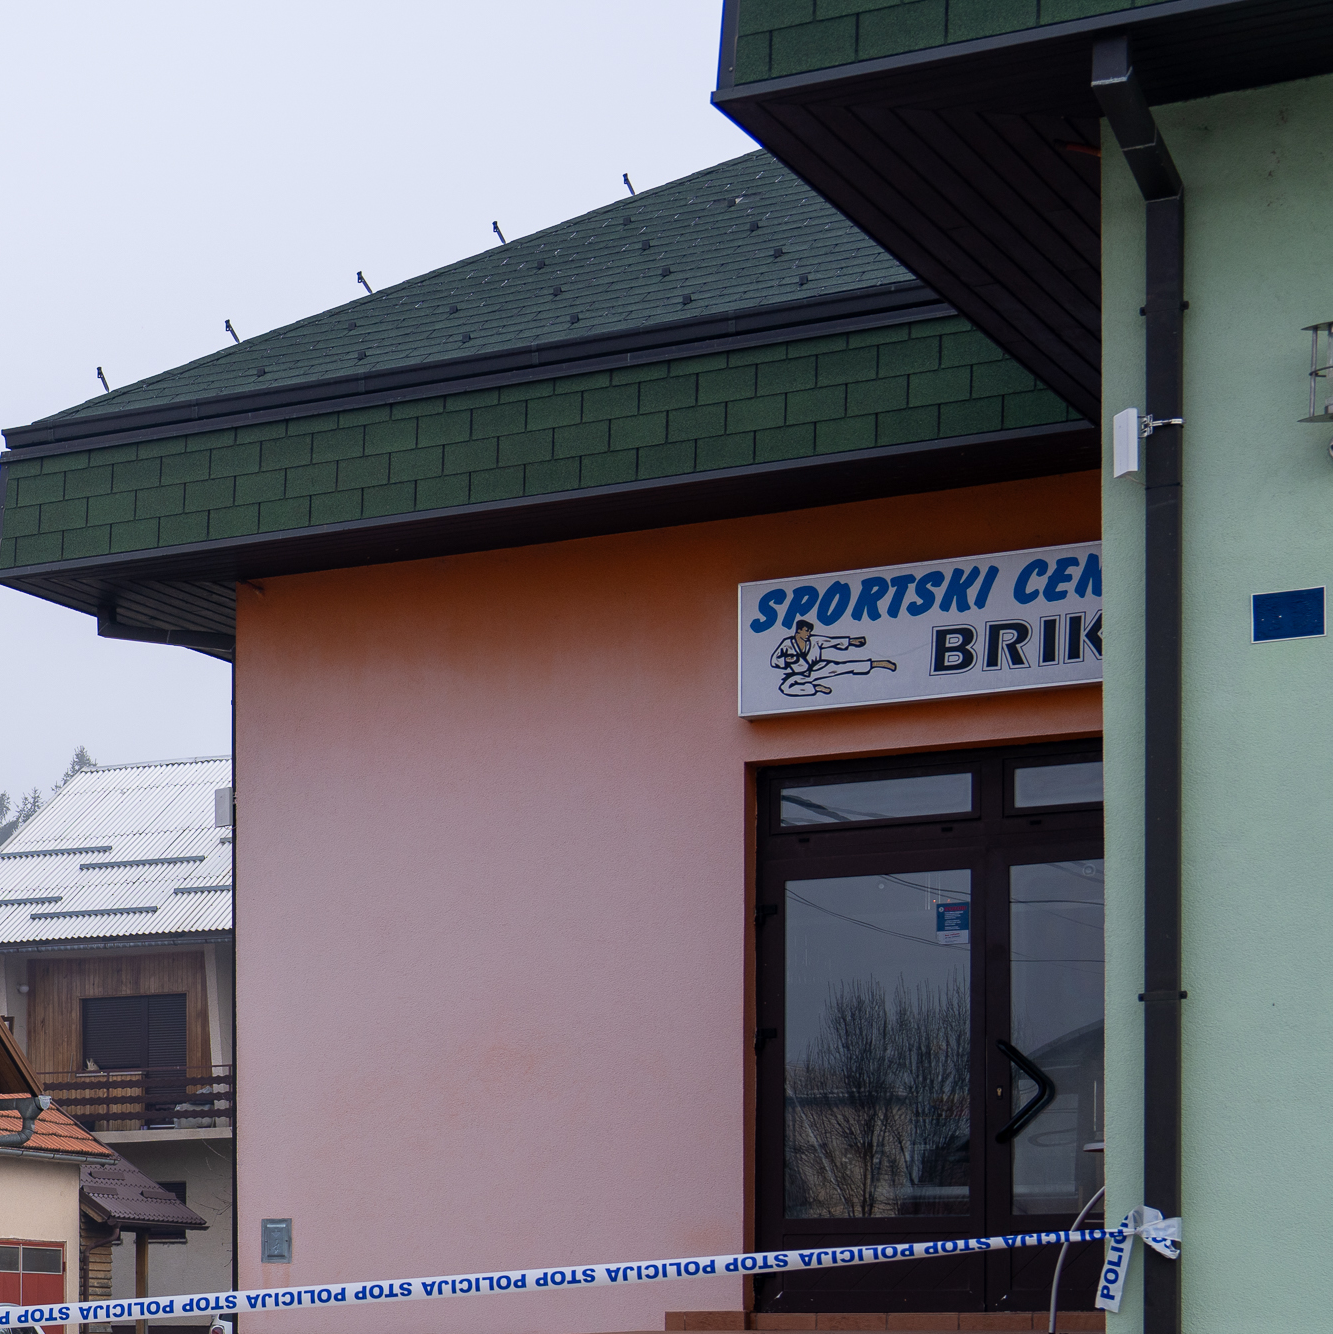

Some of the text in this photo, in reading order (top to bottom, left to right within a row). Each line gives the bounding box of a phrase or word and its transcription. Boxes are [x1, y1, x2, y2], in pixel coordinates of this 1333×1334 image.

[749, 564, 1000, 634] SPORTSKI
[929, 608, 1103, 677] BRIK
[798, 1243, 914, 1266] POLICIJA
[924, 1237, 991, 1255] STOP
[605, 1259, 716, 1282] POLICIJA
[725, 1254, 788, 1272] STOP
[421, 1274, 526, 1296] POLICIJA
[535, 1268, 596, 1287] STOP
[246, 1287, 346, 1309] POLICIJA
[354, 1282, 412, 1300] STOP
[78, 1300, 174, 1320] POLICIJA
[182, 1295, 237, 1312] STOP
[17, 1307, 70, 1323] STOP
